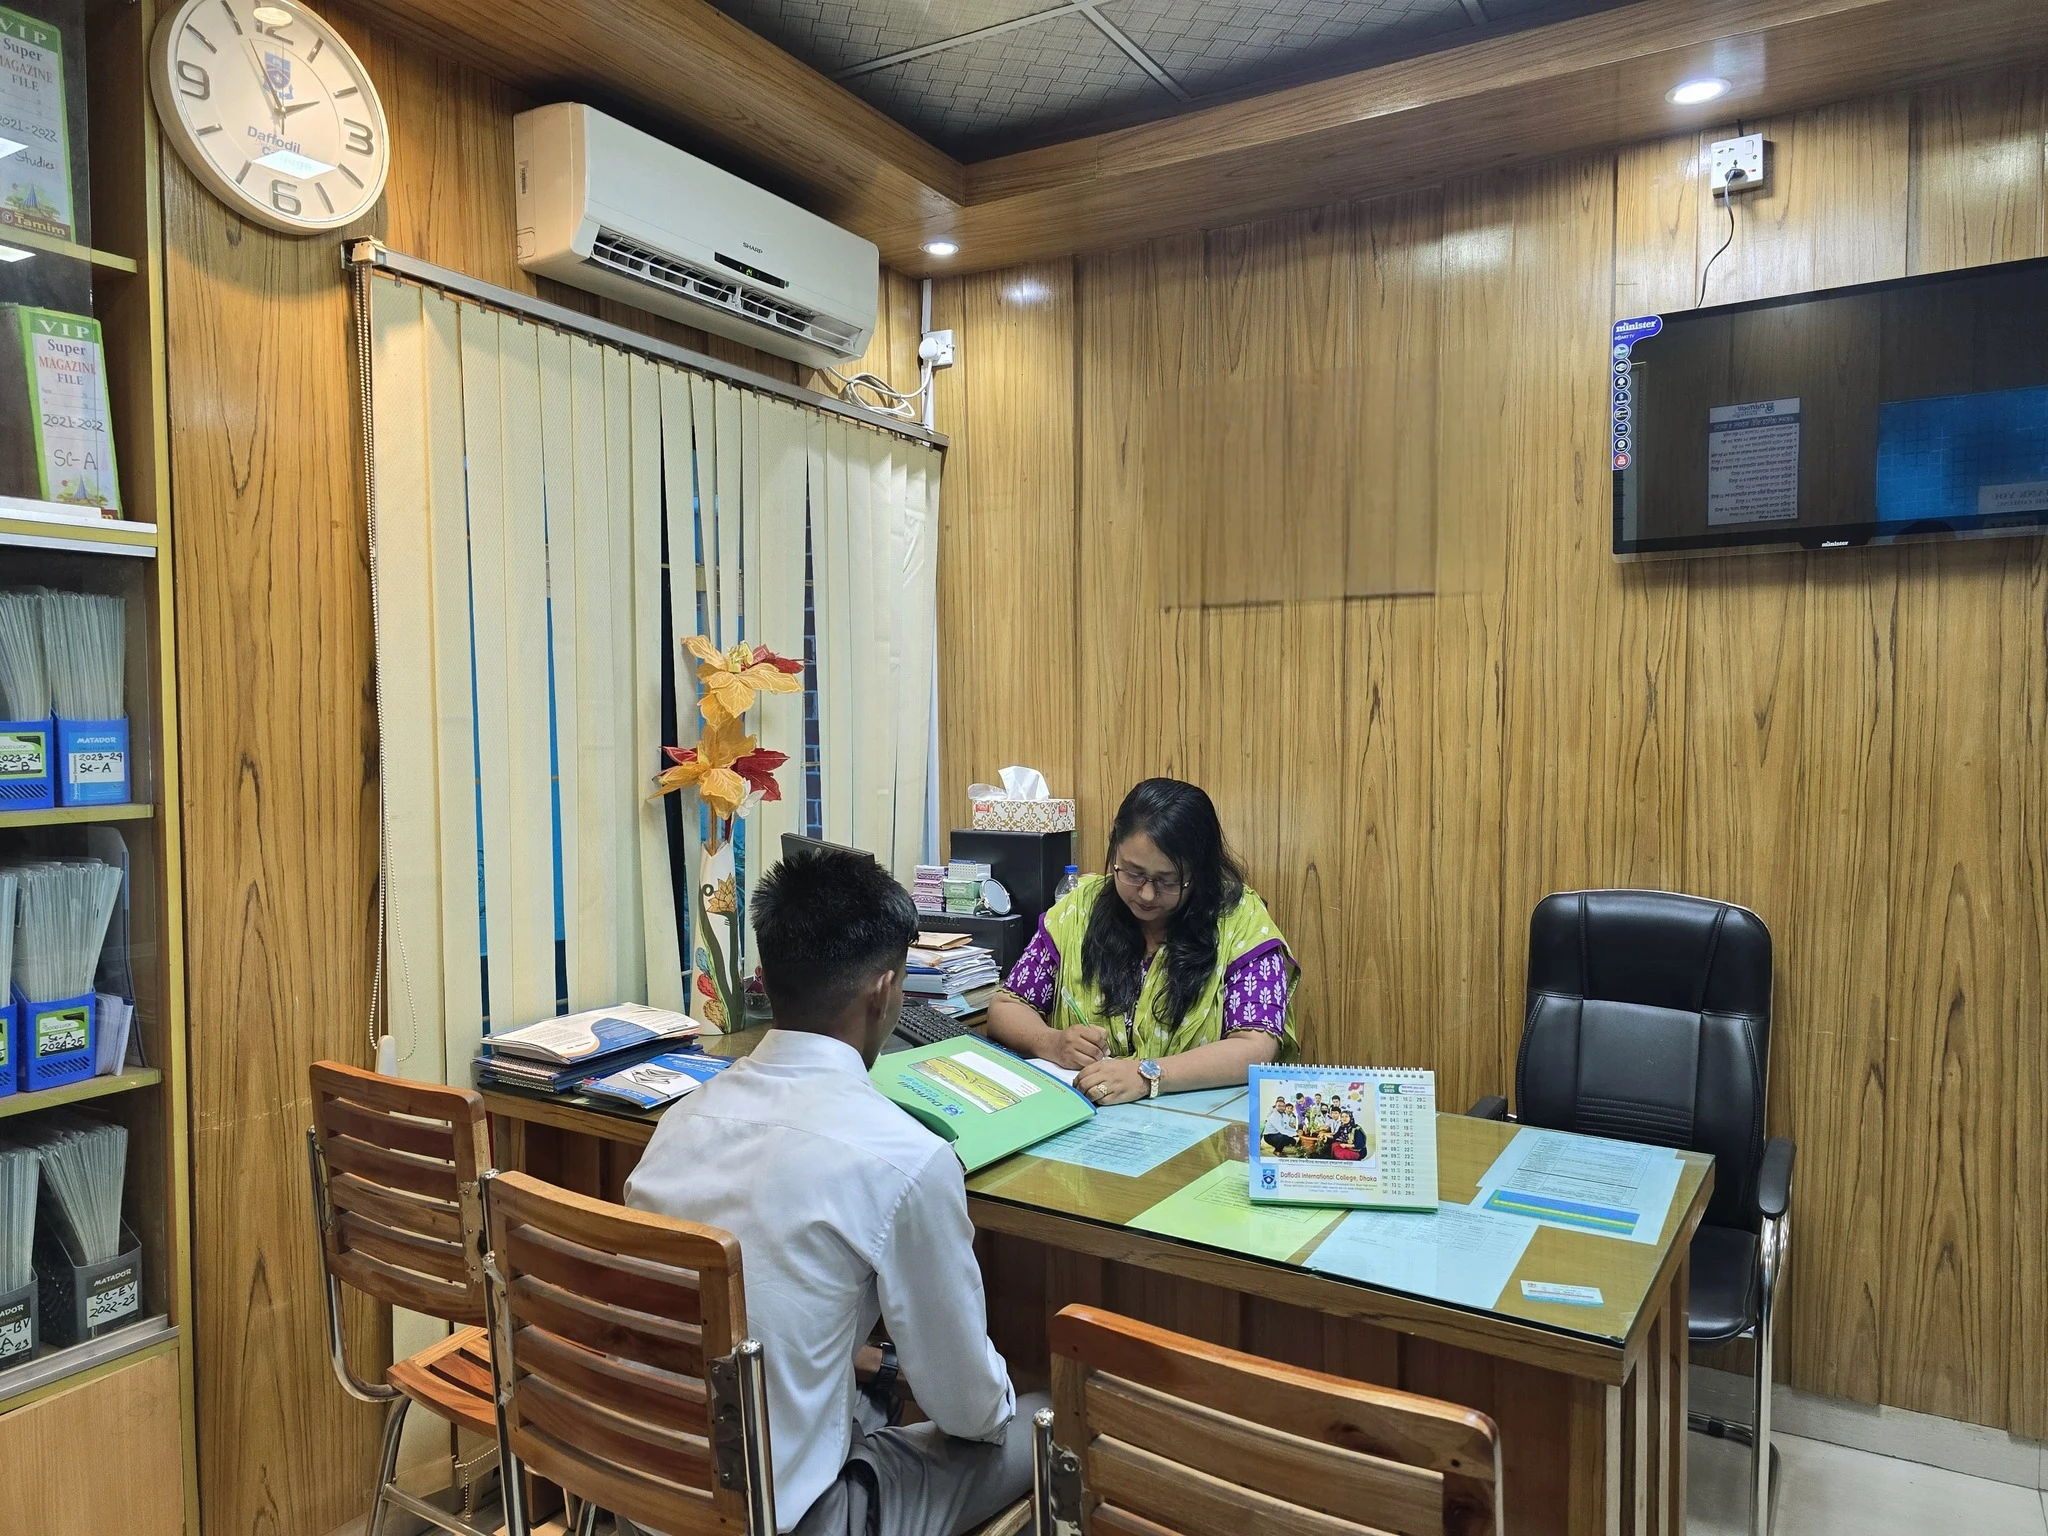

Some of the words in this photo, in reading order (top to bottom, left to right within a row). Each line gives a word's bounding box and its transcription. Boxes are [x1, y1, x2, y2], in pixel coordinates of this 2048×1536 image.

[0, 18, 47, 45] VIP
[3, 38, 42, 61] Super
[12, 73, 39, 92] FILE
[177, 60, 210, 101] 9
[247, 125, 301, 154] Daffodil
[344, 117, 374, 156] 3
[15, 151, 55, 170] Studies
[271, 179, 302, 217] 6
[14, 212, 66, 236] Tamim
[742, 241, 764, 254] SHARP
[39, 319, 90, 339] VIP
[1615, 319, 1658, 332] minister
[47, 338, 87, 356] Super
[39, 355, 96, 375] MAGAZINE
[57, 372, 84, 386] FILE
[42, 413, 105, 432] 2021-2022
[76, 736, 117, 744] MATADOR
[79, 752, 122, 763] 2023-24
[39, 1036, 85, 1053] 2024-25
[897, 1081, 943, 1107] Daffodil
[1280, 1171, 1301, 1179] Daffodil
[1335, 1174, 1359, 1183] College,
[1359, 1174, 1377, 1182] Dhaka
[93, 1268, 132, 1287] MATADOR
[0, 1304, 24, 1317] ADOR
[89, 1293, 136, 1318] 2022-23
